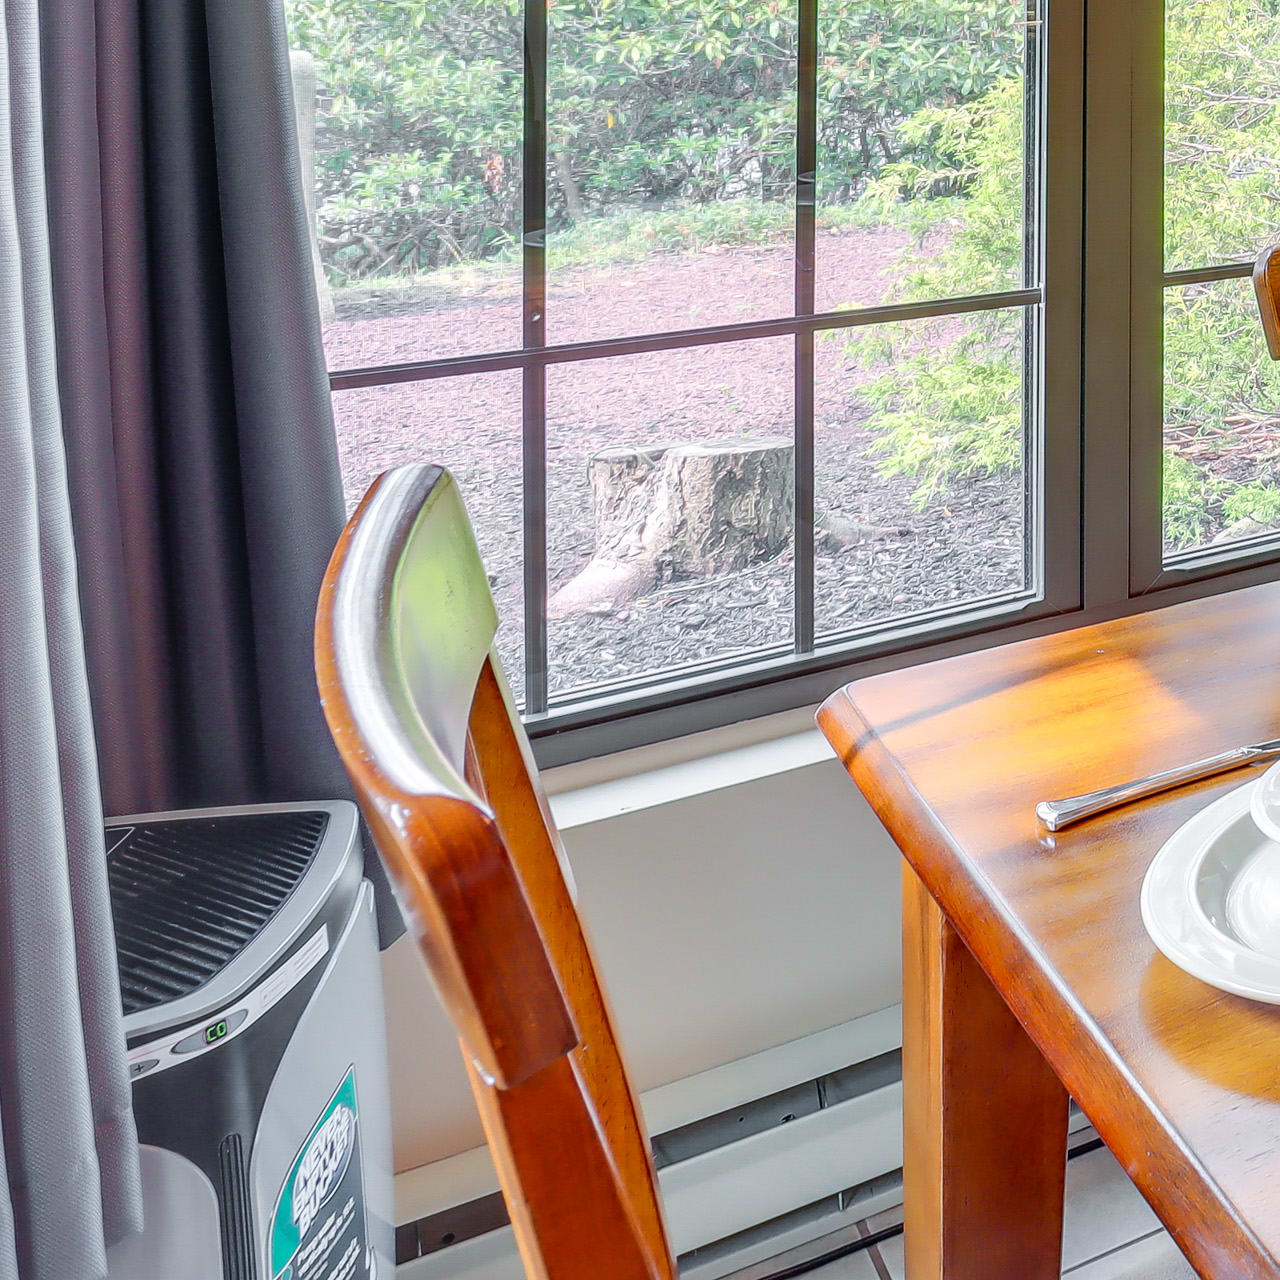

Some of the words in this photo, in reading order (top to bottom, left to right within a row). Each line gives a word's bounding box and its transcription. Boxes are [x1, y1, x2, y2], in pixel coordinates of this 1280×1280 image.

[293, 1132, 336, 1225] EMPTY
[298, 1103, 343, 1190] NEVER
[300, 1123, 349, 1241] BUCKET
